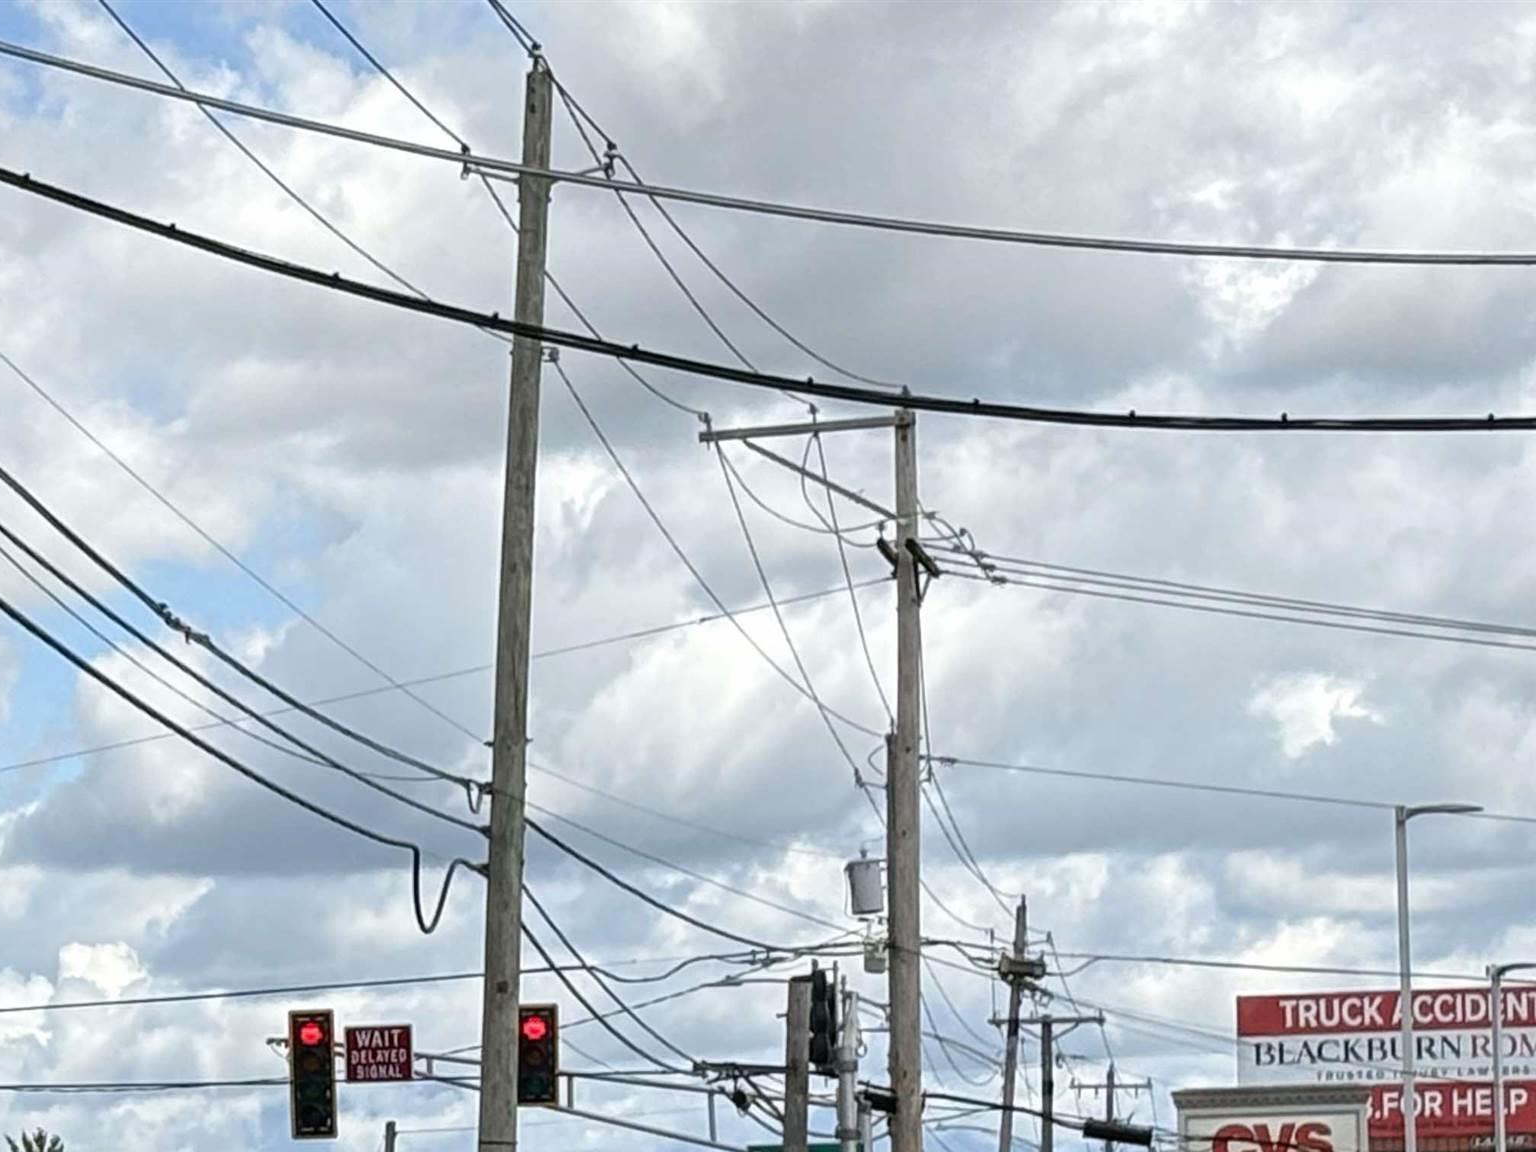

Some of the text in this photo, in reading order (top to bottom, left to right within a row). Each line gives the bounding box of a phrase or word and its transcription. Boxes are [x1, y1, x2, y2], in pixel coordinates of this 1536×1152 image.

[1278, 998, 1383, 1029] TRUCK
[356, 1030, 402, 1048] WAIT
[351, 1049, 407, 1064] DELAYED
[1254, 1034, 1461, 1066] BLACKBURN
[357, 1064, 403, 1079] SIGNAL
[1316, 1069, 1385, 1081] TRUSTED
[1457, 1065, 1530, 1077] LAWERS
[1452, 1088, 1528, 1117] HEP
